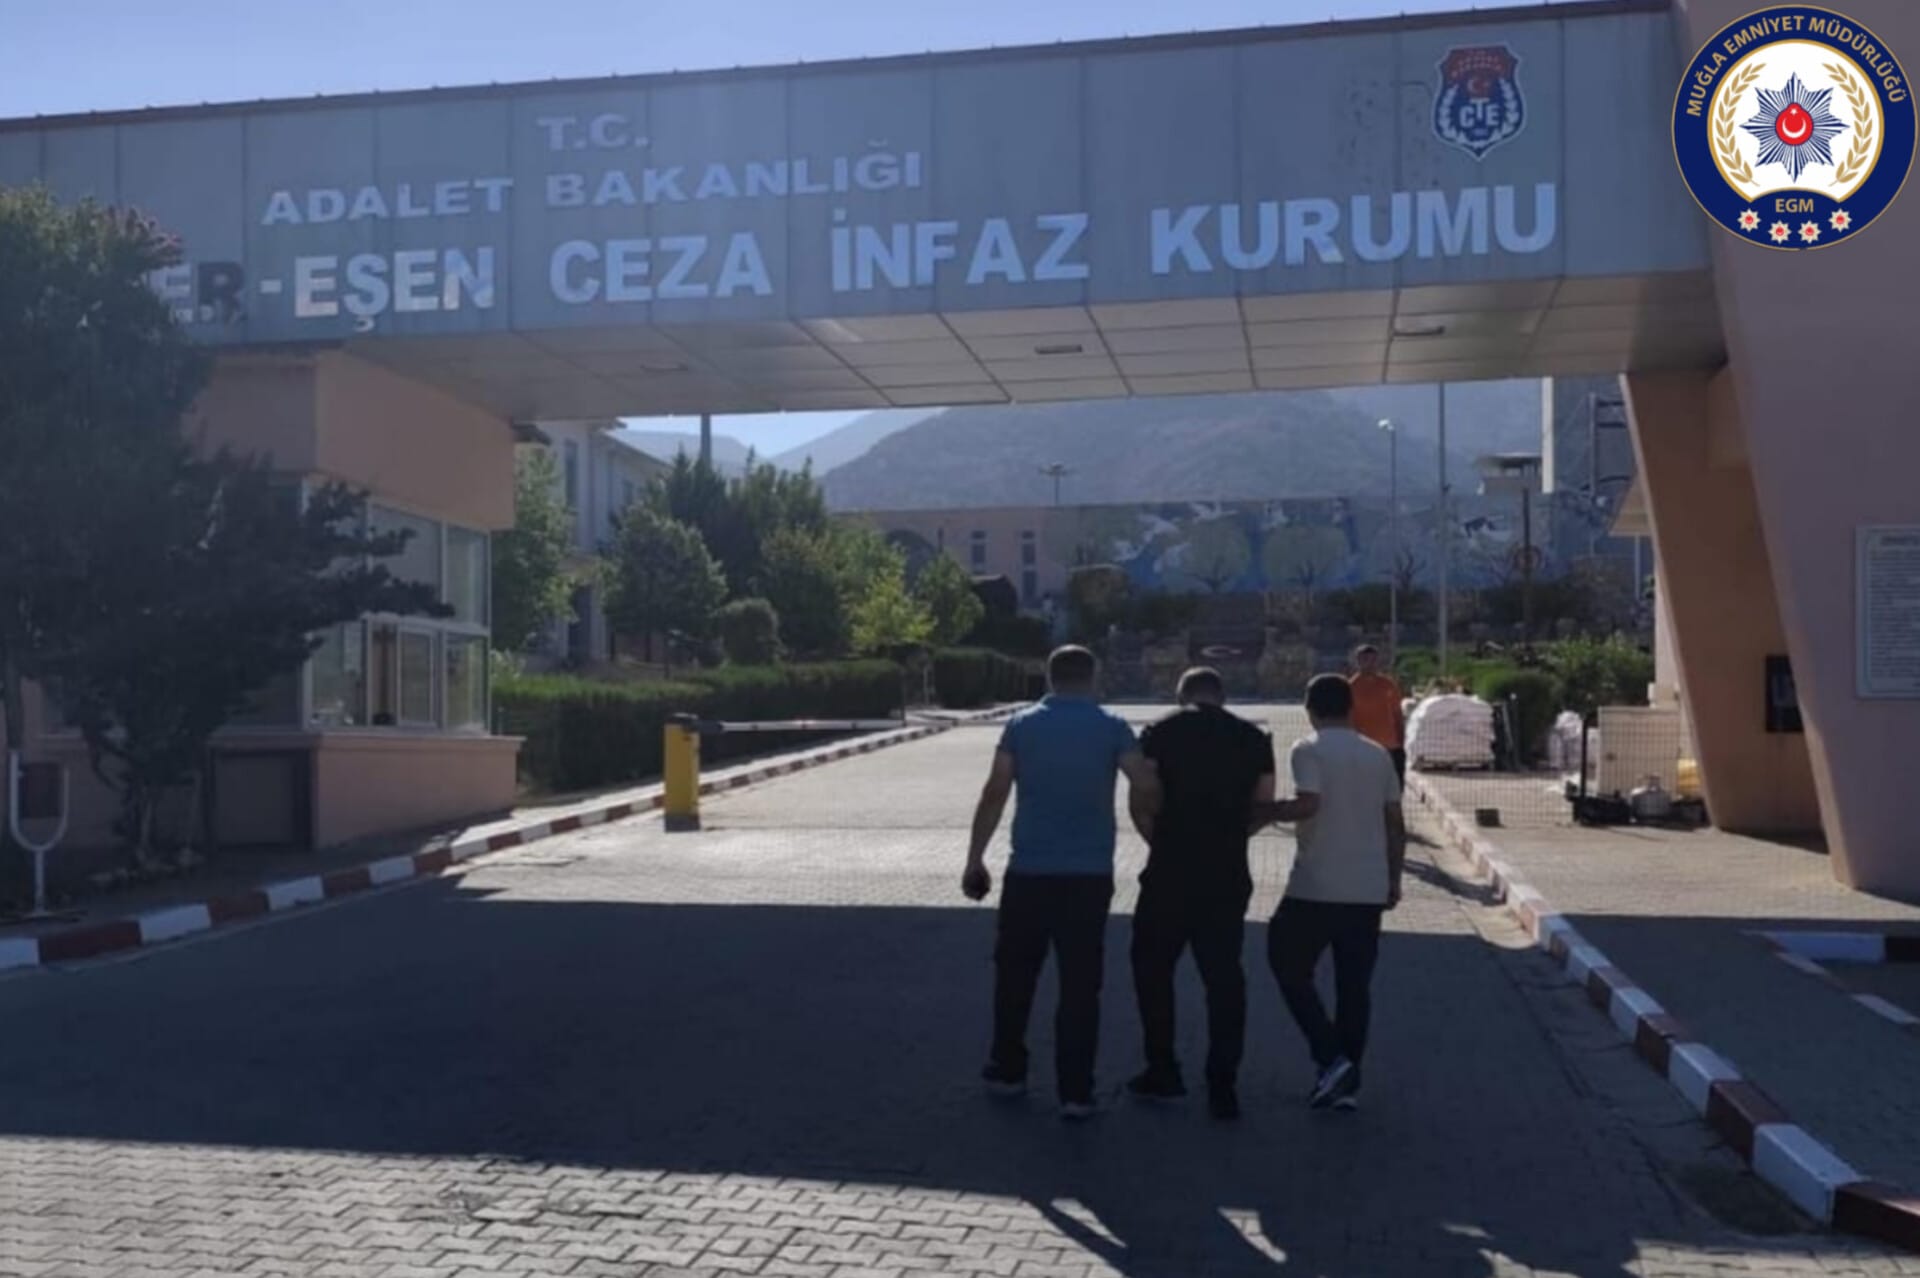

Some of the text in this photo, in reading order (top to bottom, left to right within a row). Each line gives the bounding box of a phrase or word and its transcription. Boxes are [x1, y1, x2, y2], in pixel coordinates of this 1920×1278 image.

[537, 113, 649, 151] T.C.
[261, 139, 921, 225] ADALET BAKANLIĞI
[146, 183, 1557, 332] ER-EŞEN CEZA İNFAZ KURUMU
